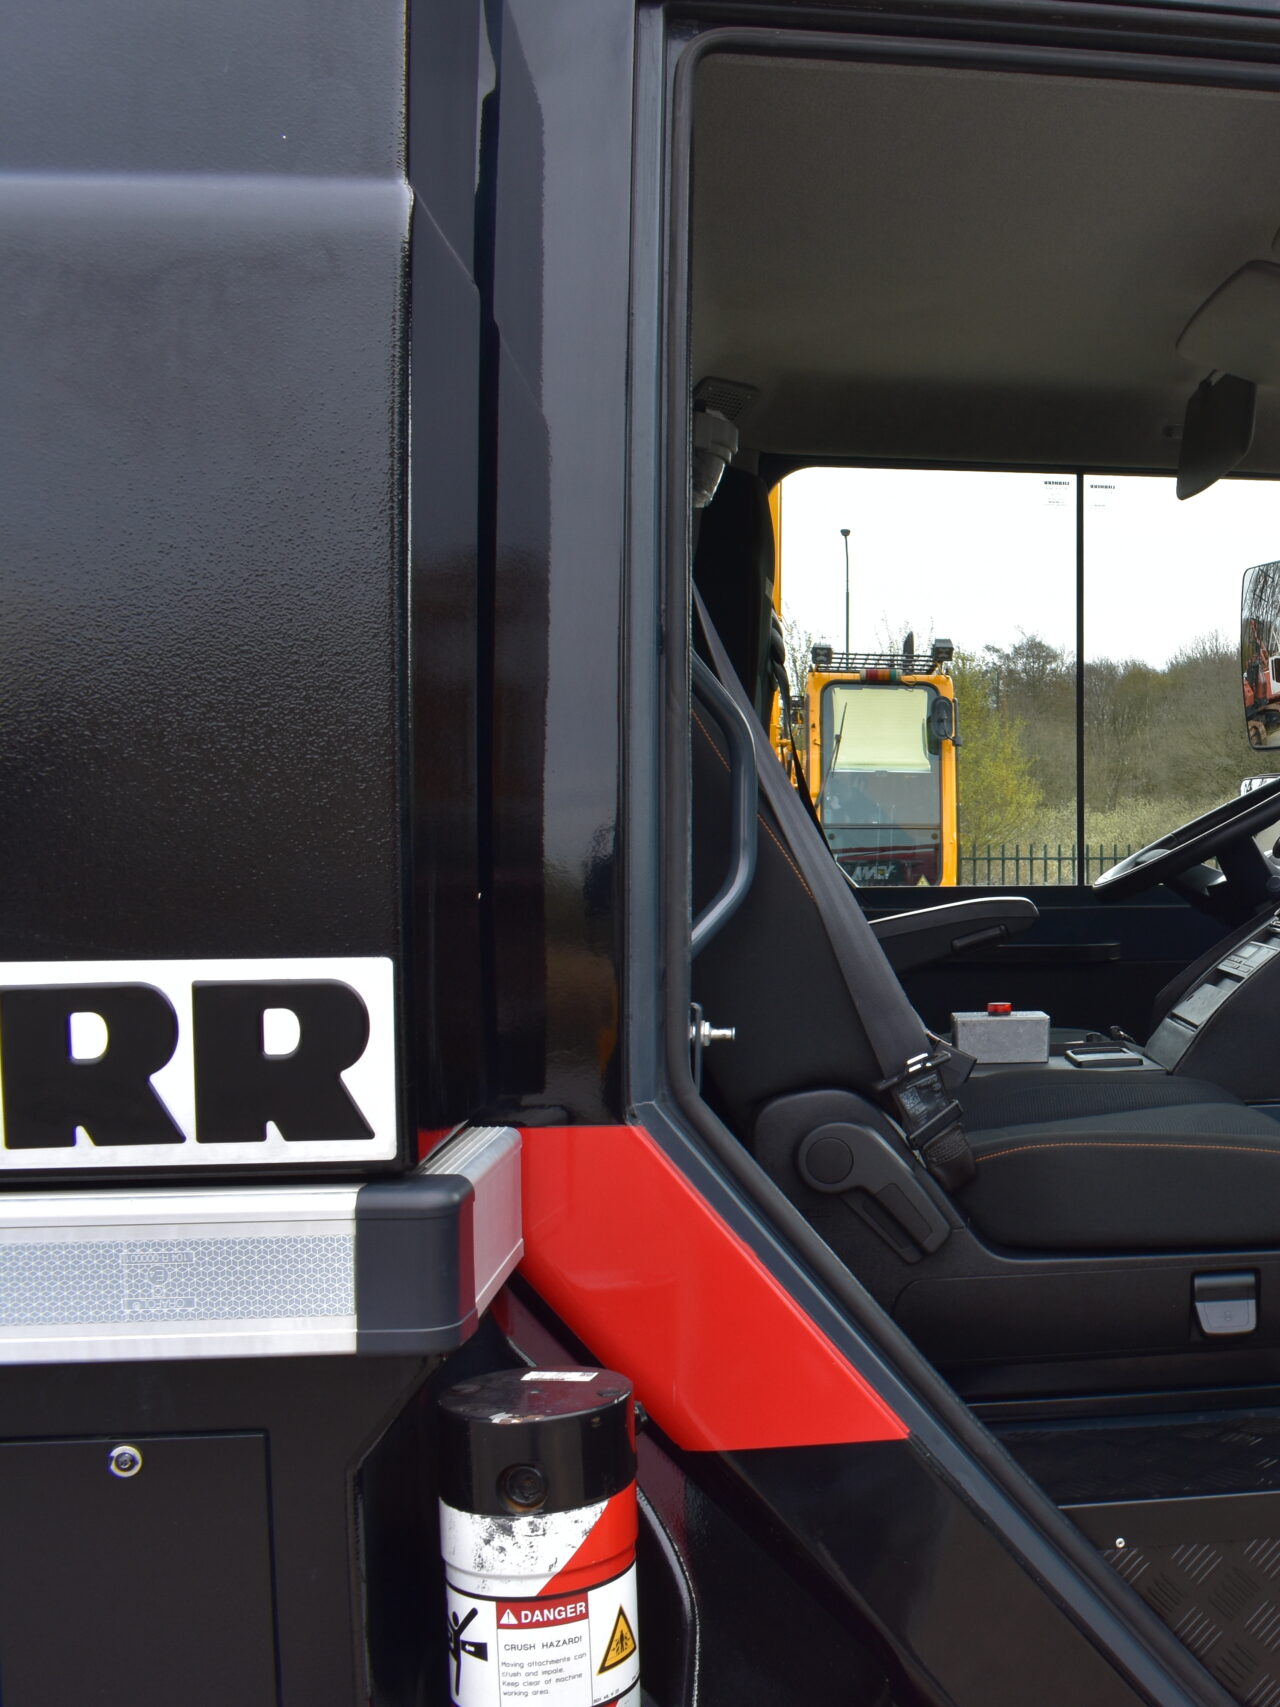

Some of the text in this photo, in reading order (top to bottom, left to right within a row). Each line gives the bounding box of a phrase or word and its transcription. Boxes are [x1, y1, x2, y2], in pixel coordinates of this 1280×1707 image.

[521, 1602, 586, 1624] DANGER
[504, 1635, 582, 1652] CRUSH HAZARD!
[501, 1652, 587, 1669] Moving attachments can
[502, 1670, 522, 1678] crush
[502, 1680, 520, 1688] Keep
[522, 1679, 541, 1687] clear
[555, 1673, 583, 1683] machine
[503, 1690, 529, 1698] working
